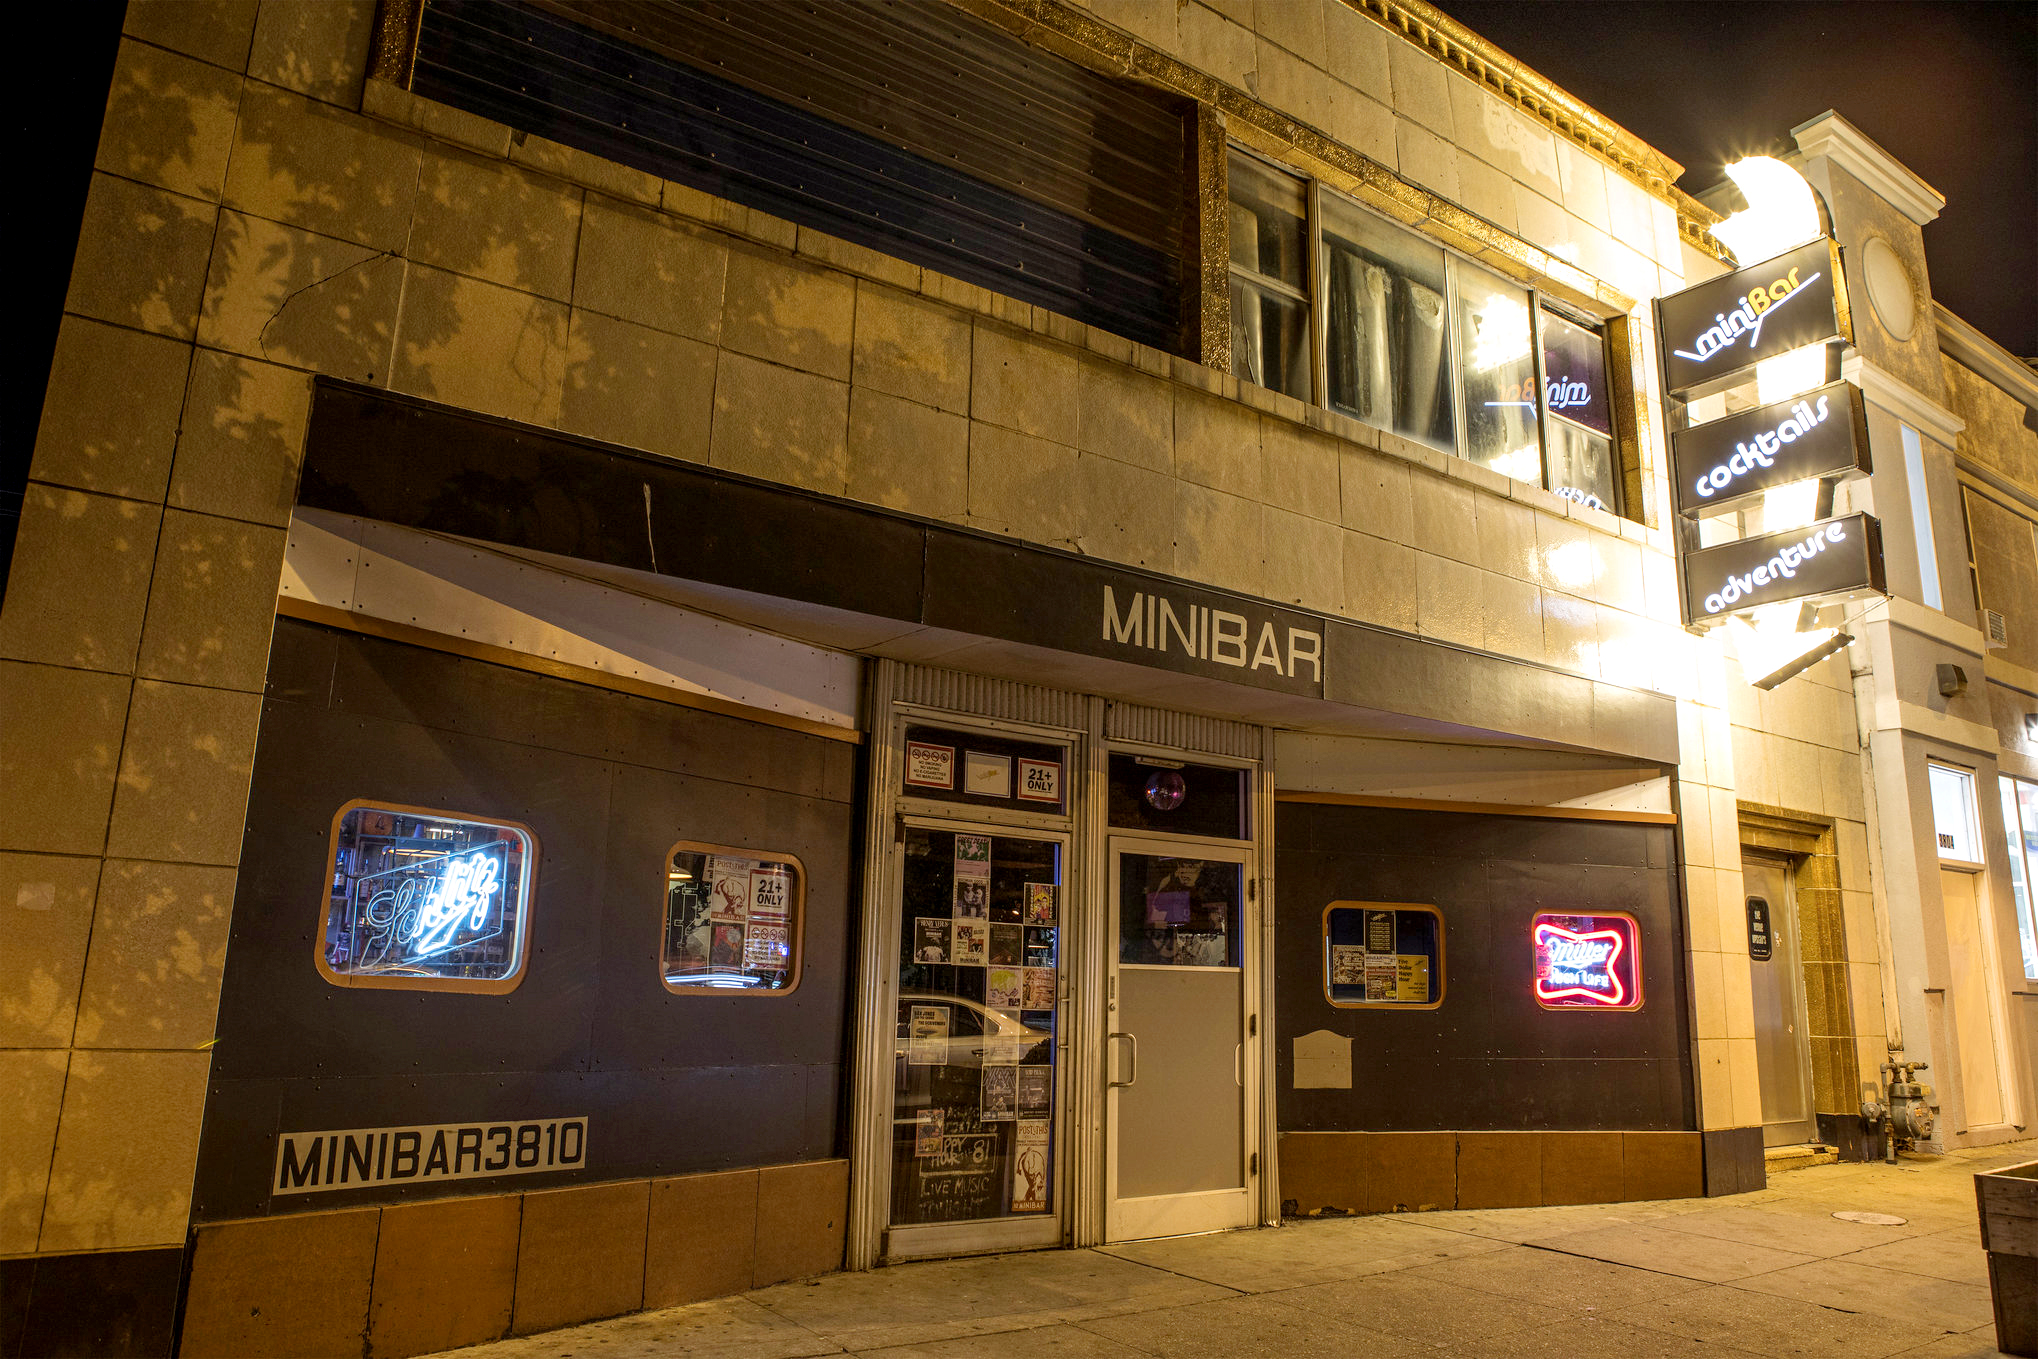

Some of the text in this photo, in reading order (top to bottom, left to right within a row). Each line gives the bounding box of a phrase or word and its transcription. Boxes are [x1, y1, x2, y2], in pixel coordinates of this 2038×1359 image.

[1680, 266, 1815, 361] miniBar
[1695, 395, 1829, 498] cocktails
[1704, 522, 1846, 613] adventure
[1102, 584, 1322, 683] MINIBAR
[1027, 780, 1053, 792] ONLY
[1028, 768, 1052, 781] 21+
[757, 894, 784, 906] ONLY
[758, 879, 782, 894] 21+
[279, 1121, 584, 1189] MINIBAR3810
[954, 1177, 989, 1197] MUSIC
